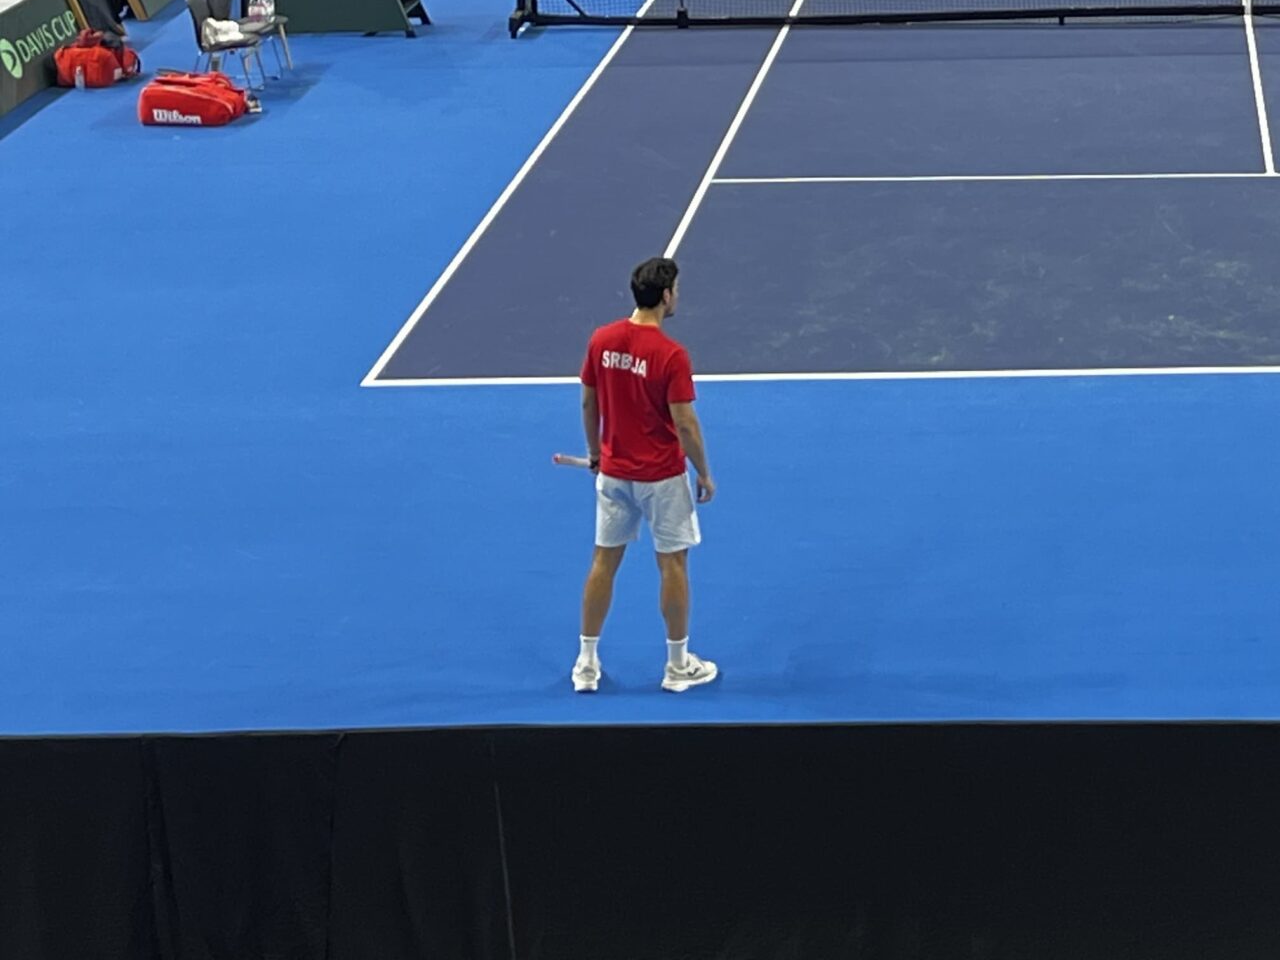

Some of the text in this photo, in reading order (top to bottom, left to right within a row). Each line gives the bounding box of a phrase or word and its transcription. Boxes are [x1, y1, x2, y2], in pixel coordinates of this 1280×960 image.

[15, 10, 76, 63] DAVIS CUP
[152, 108, 202, 124] Wilson
